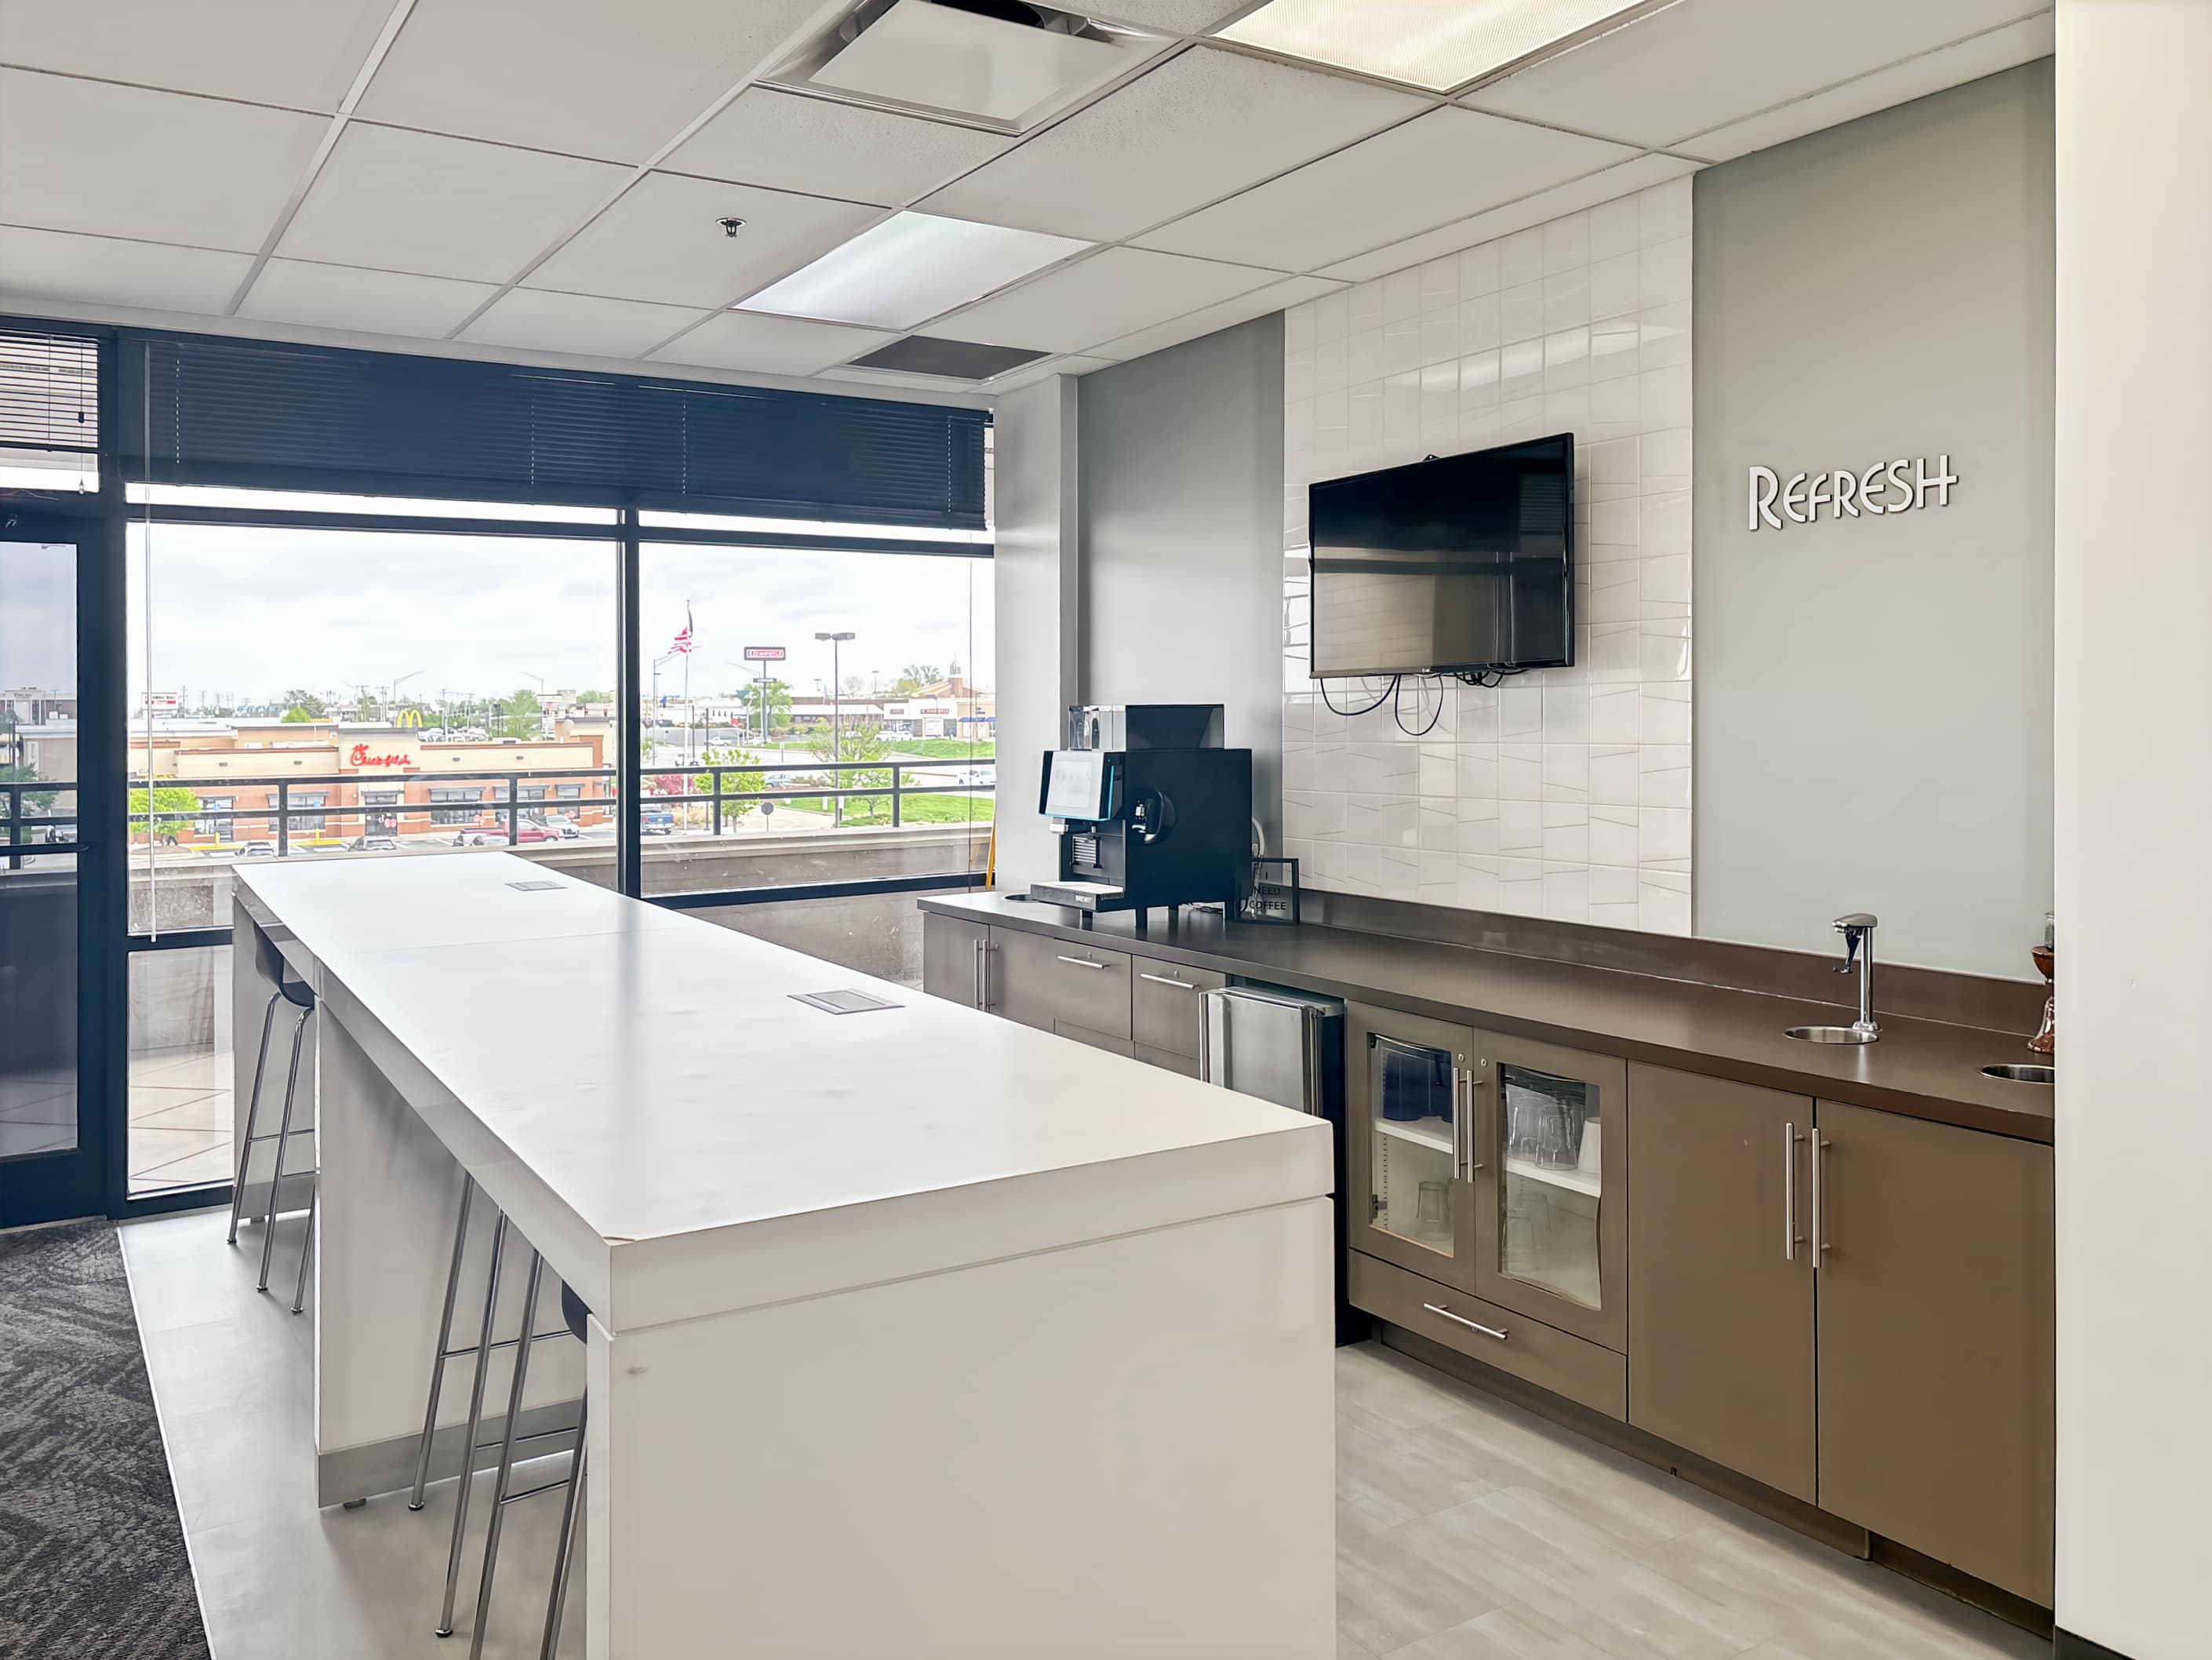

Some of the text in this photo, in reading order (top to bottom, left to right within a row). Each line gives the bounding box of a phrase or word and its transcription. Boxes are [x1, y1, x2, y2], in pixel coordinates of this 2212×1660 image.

[1749, 454, 1959, 531] REFRESH
[1254, 886, 1281, 895] NEED
[1249, 901, 1286, 910] COFFEE
